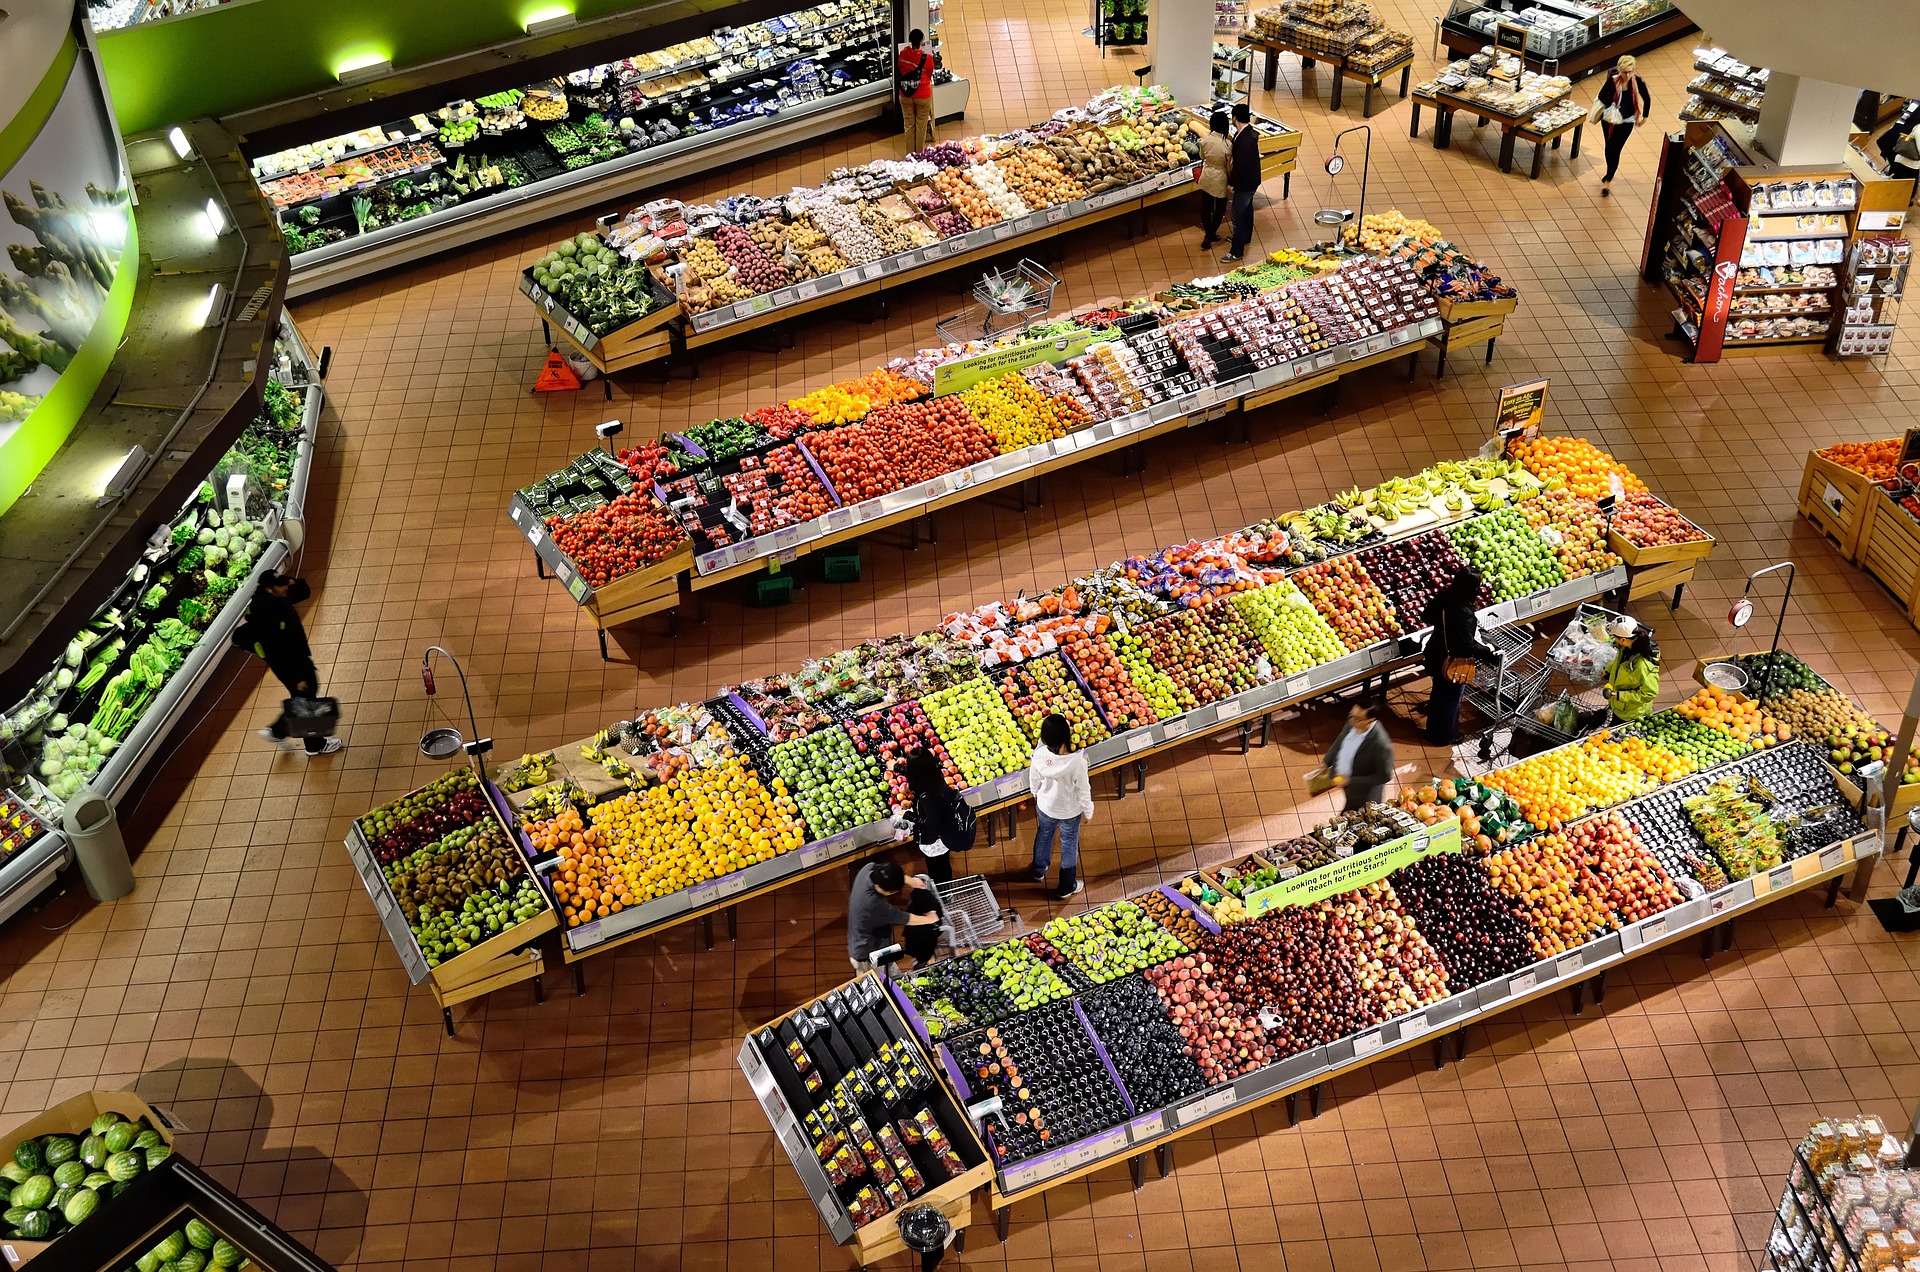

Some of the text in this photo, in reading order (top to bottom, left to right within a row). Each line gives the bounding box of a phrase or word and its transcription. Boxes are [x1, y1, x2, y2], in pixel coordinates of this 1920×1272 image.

[1714, 261, 1737, 322] Vachon
[964, 358, 986, 369] Looking
[997, 349, 1027, 361] nutritious
[1028, 342, 1052, 353] choices?
[979, 361, 997, 371] Reach
[998, 358, 1007, 366] for
[1008, 356, 1018, 364] the
[1019, 352, 1037, 361] Stars!
[1286, 878, 1318, 893] Looking
[1319, 871, 1331, 881] for
[1332, 857, 1372, 876] nutritious
[1374, 842, 1407, 860] choices?
[1308, 879, 1333, 893] Reach
[1335, 873, 1347, 884] for
[1348, 869, 1361, 880] the
[1363, 858, 1388, 873] Stars!
